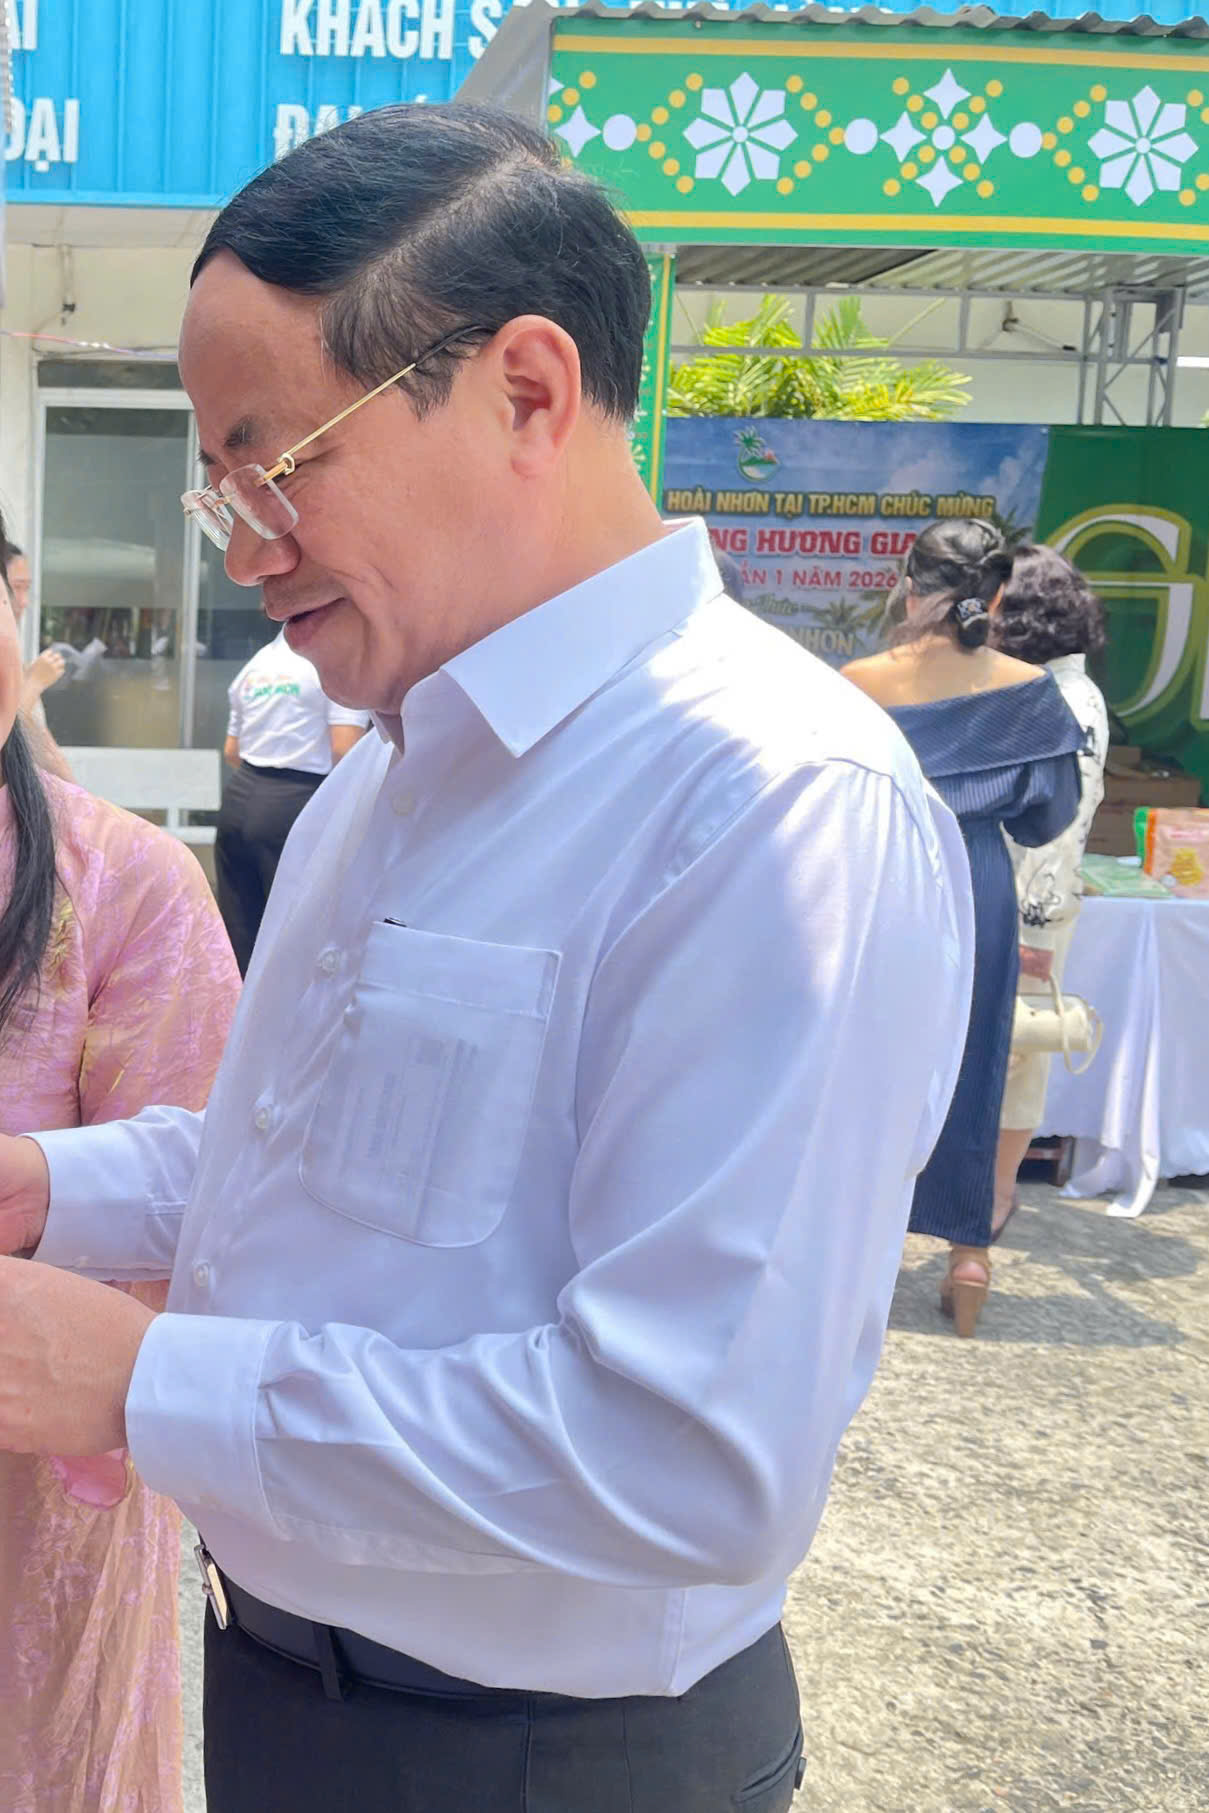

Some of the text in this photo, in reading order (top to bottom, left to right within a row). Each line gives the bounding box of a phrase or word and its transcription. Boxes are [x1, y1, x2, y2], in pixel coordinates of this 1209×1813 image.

[667, 490, 712, 512] HOÀI
[775, 495, 803, 519] TẠI
[809, 495, 876, 515] TP.HCM
[881, 491, 932, 516] CHÚC
[709, 528, 747, 552] NG
[793, 567, 842, 588] NĂM
[848, 571, 898, 589] 2026
